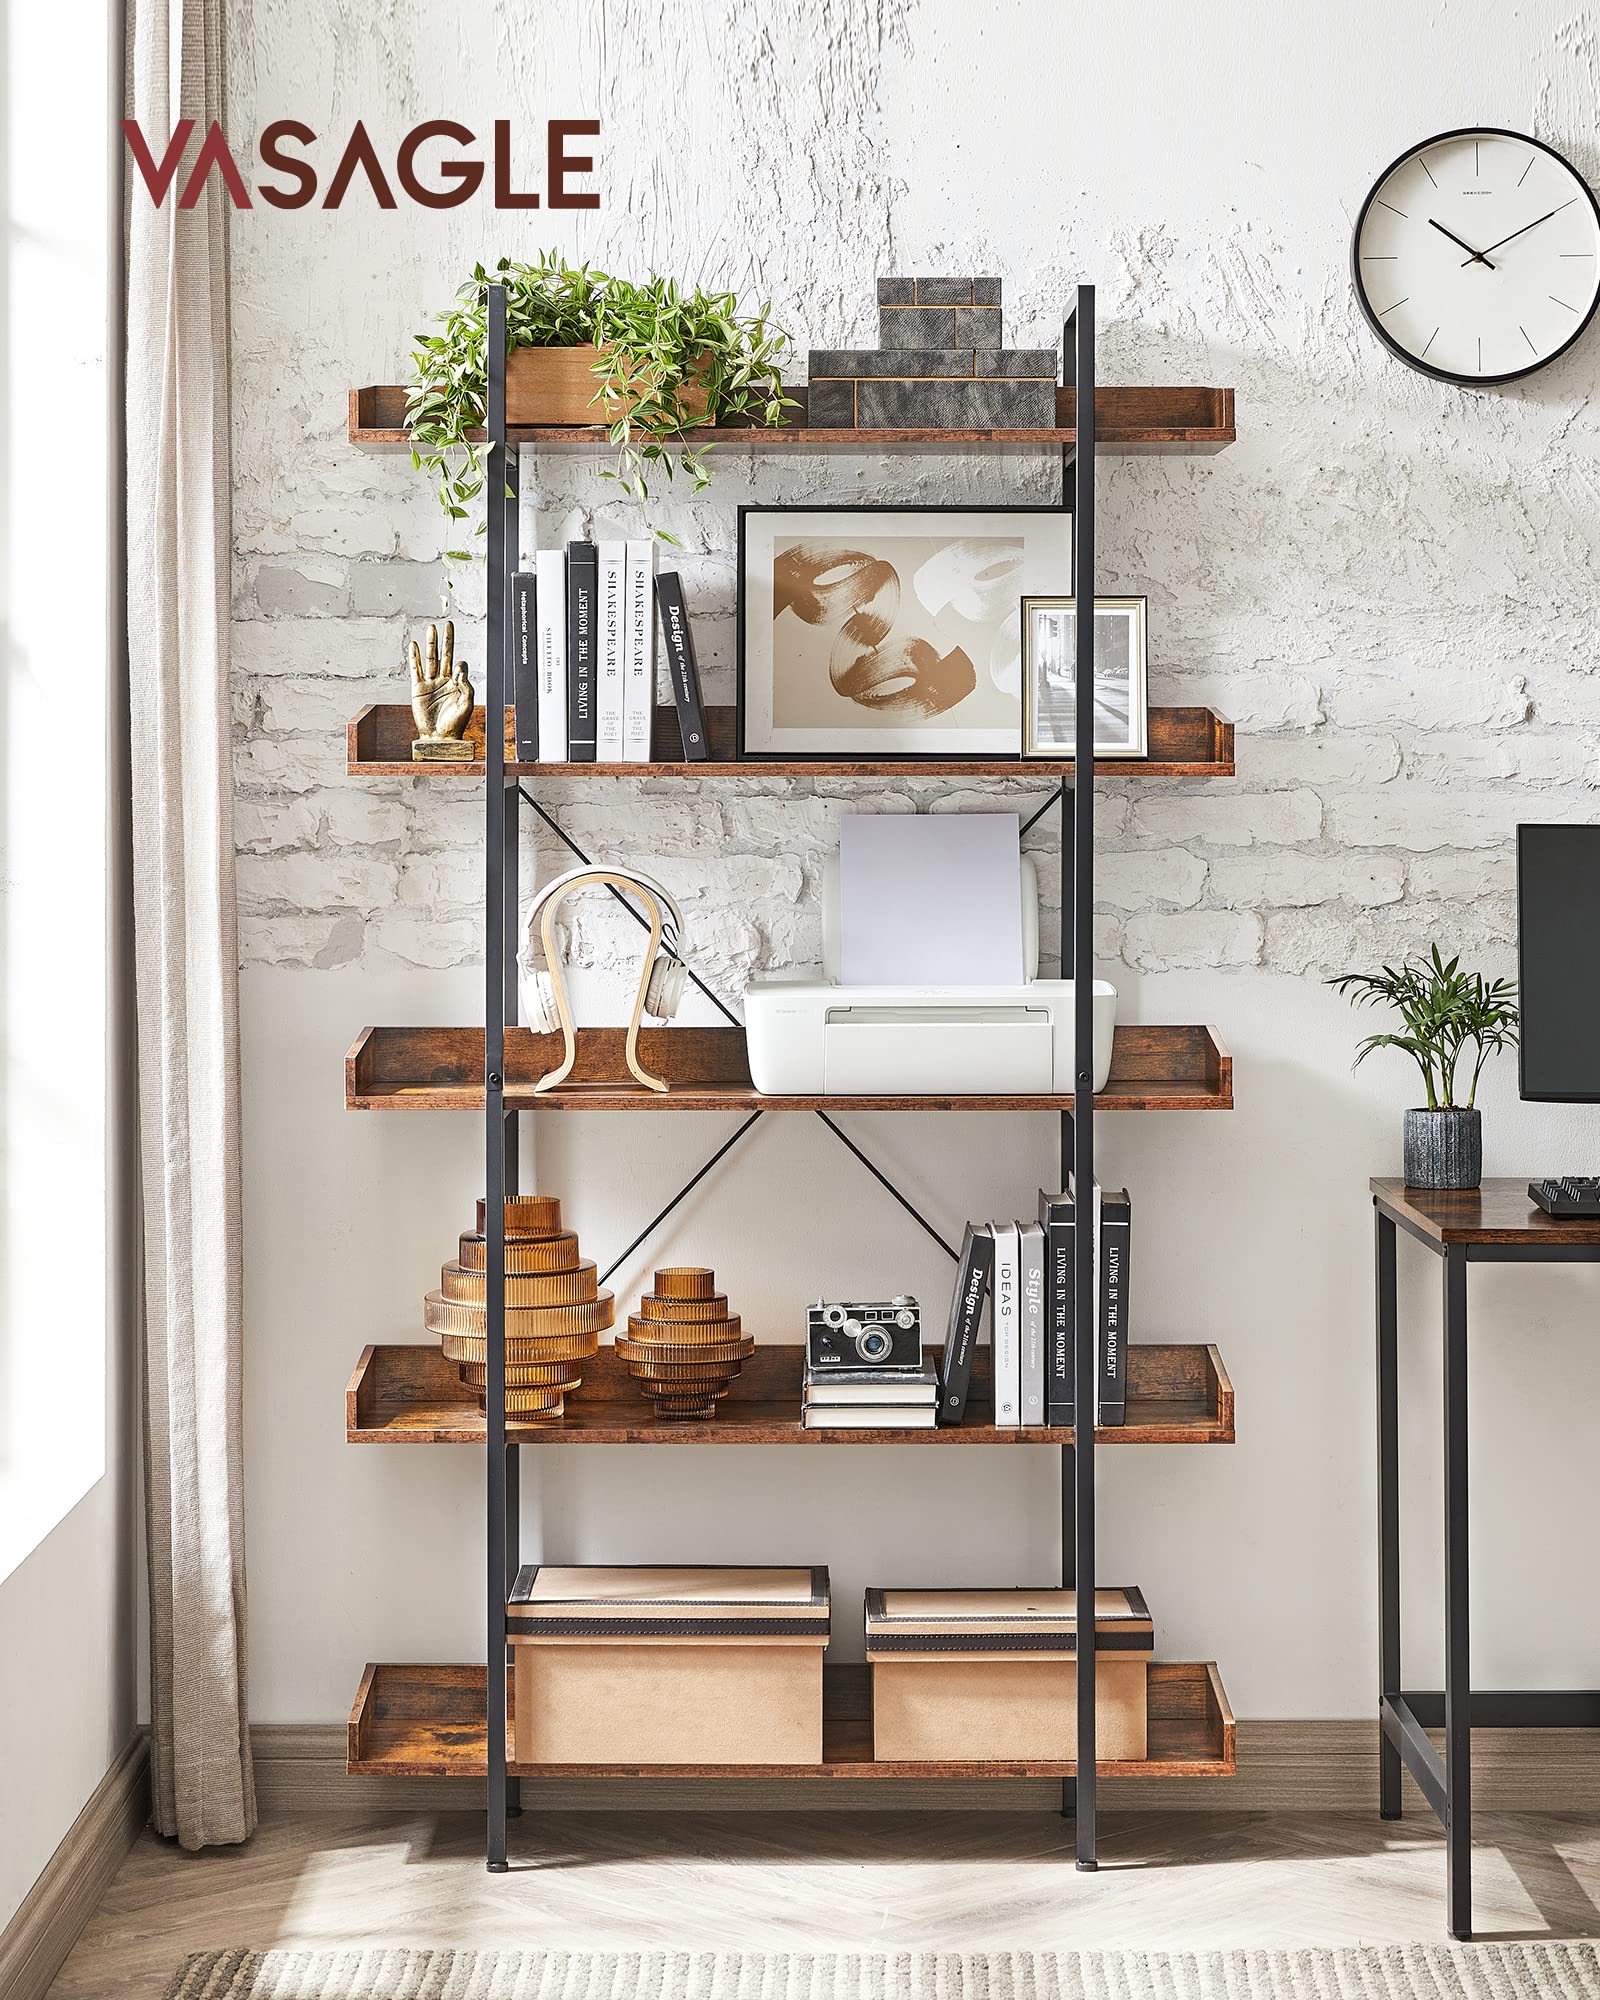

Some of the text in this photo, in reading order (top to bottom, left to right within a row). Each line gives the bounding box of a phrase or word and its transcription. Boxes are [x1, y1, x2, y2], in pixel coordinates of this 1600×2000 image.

[520, 591, 528, 633] Metaphorical
[607, 570, 617, 677] SHAKESPEARE
[634, 570, 644, 677] SHAKESPEARE
[669, 606, 684, 652] Design
[578, 588, 589, 719] LIVING IN THE MOMENT
[965, 1268, 983, 1315] Design
[1001, 1263, 1011, 1317] IDEAS
[1026, 1268, 1040, 1314] Style
[1056, 1248, 1067, 1379] LIVING IN THE MOMENT
[1107, 1247, 1119, 1379] LIVING IN THE MOMENT
[965, 1318, 972, 1326] of
[1030, 1320, 1037, 1328] of
[957, 1346, 965, 1365] century
